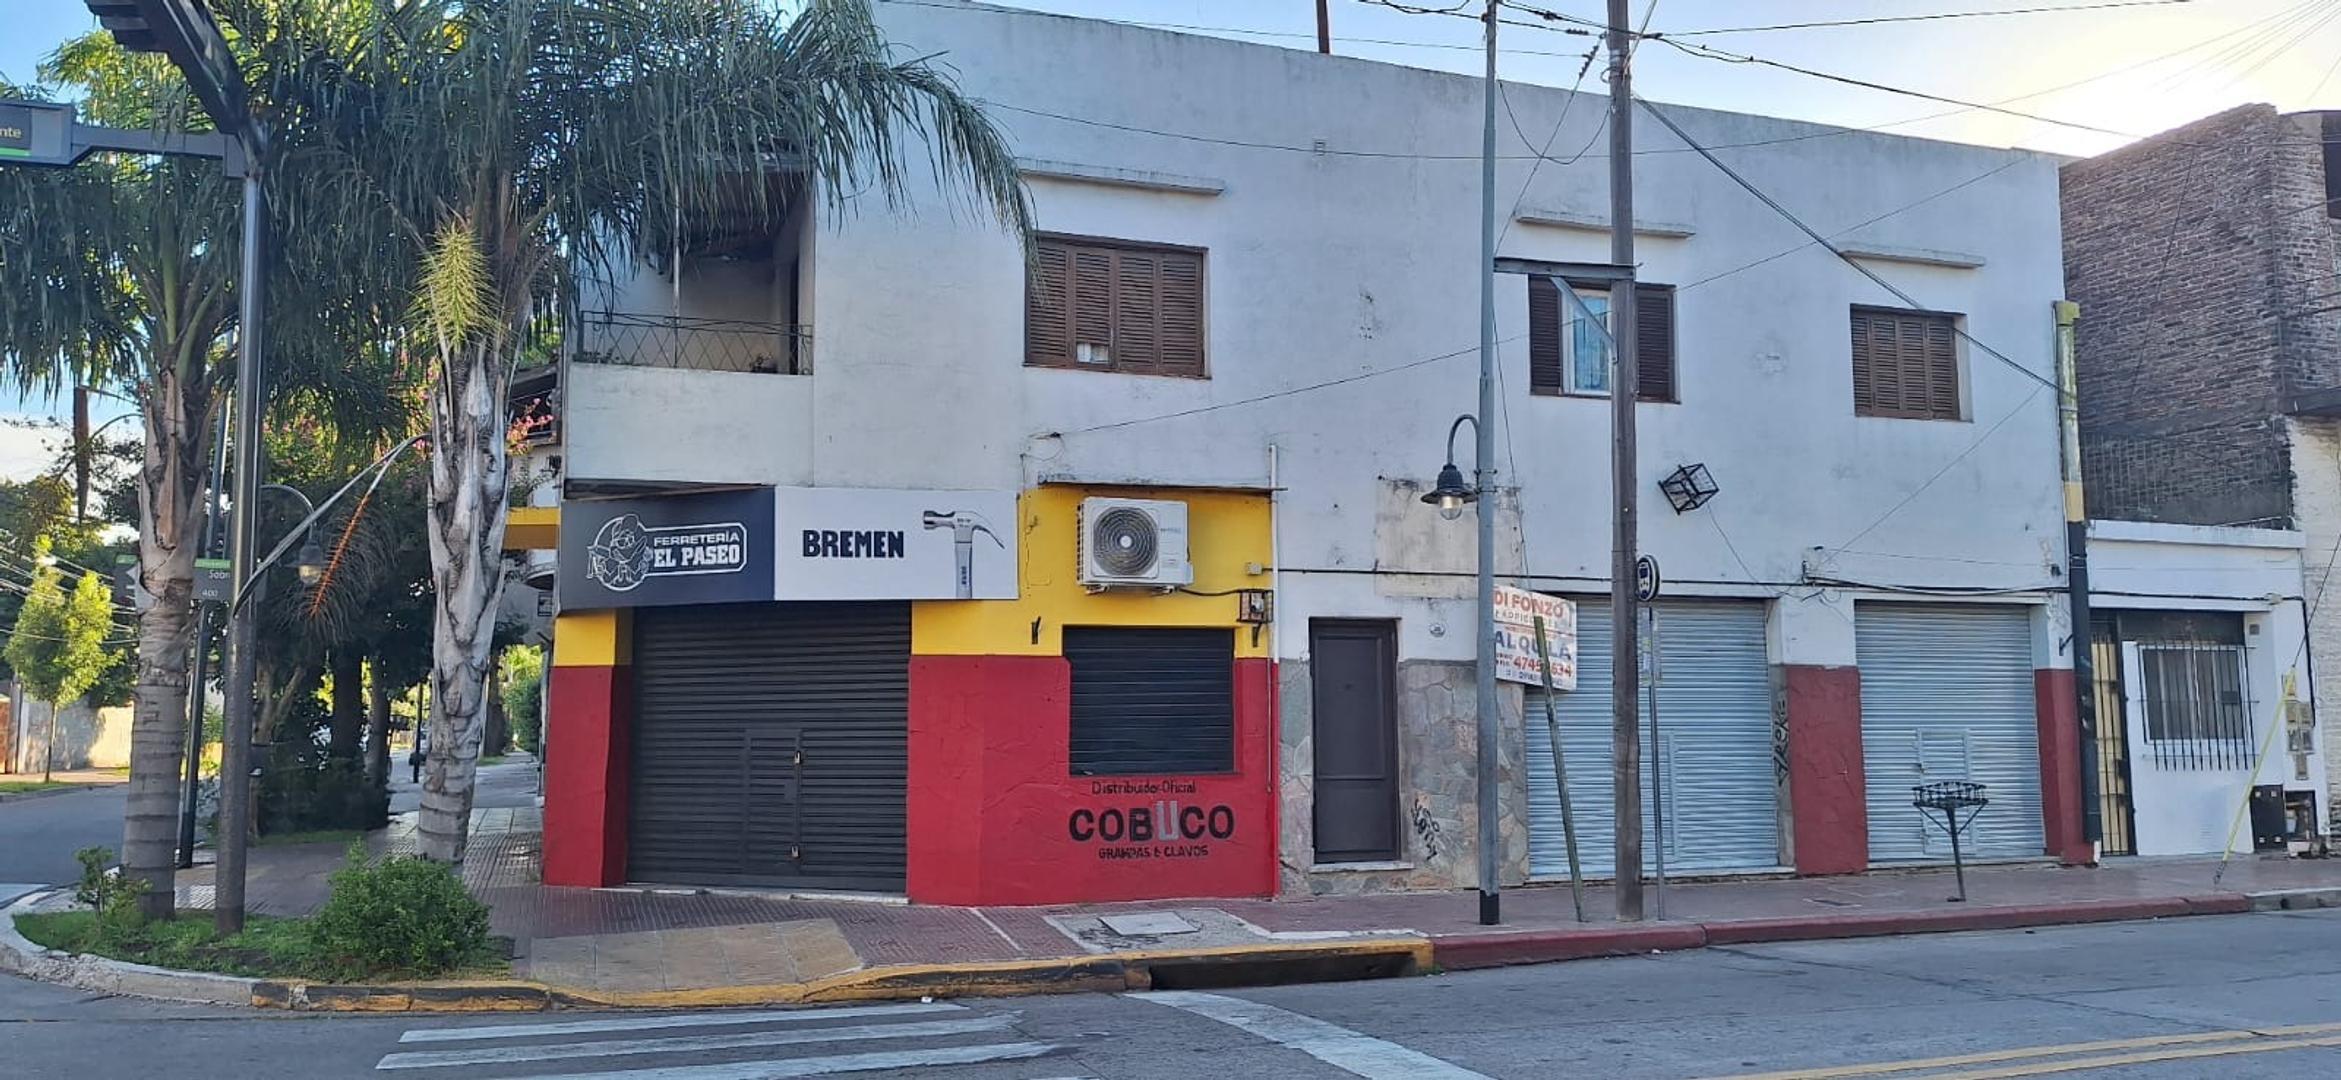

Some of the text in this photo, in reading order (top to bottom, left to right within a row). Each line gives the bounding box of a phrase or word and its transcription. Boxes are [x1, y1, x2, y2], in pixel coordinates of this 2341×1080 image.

[653, 544, 740, 568] EL PASEO
[802, 529, 905, 559] BREMEN
[201, 589, 218, 597] 400
[1511, 594, 1564, 618] FONZO
[1494, 630, 1572, 660] ALQULA
[1091, 779, 1197, 795] Distribuidor Oficial
[1068, 800, 1235, 843] COBUCO
[1163, 844, 1209, 858] CLAVOS
